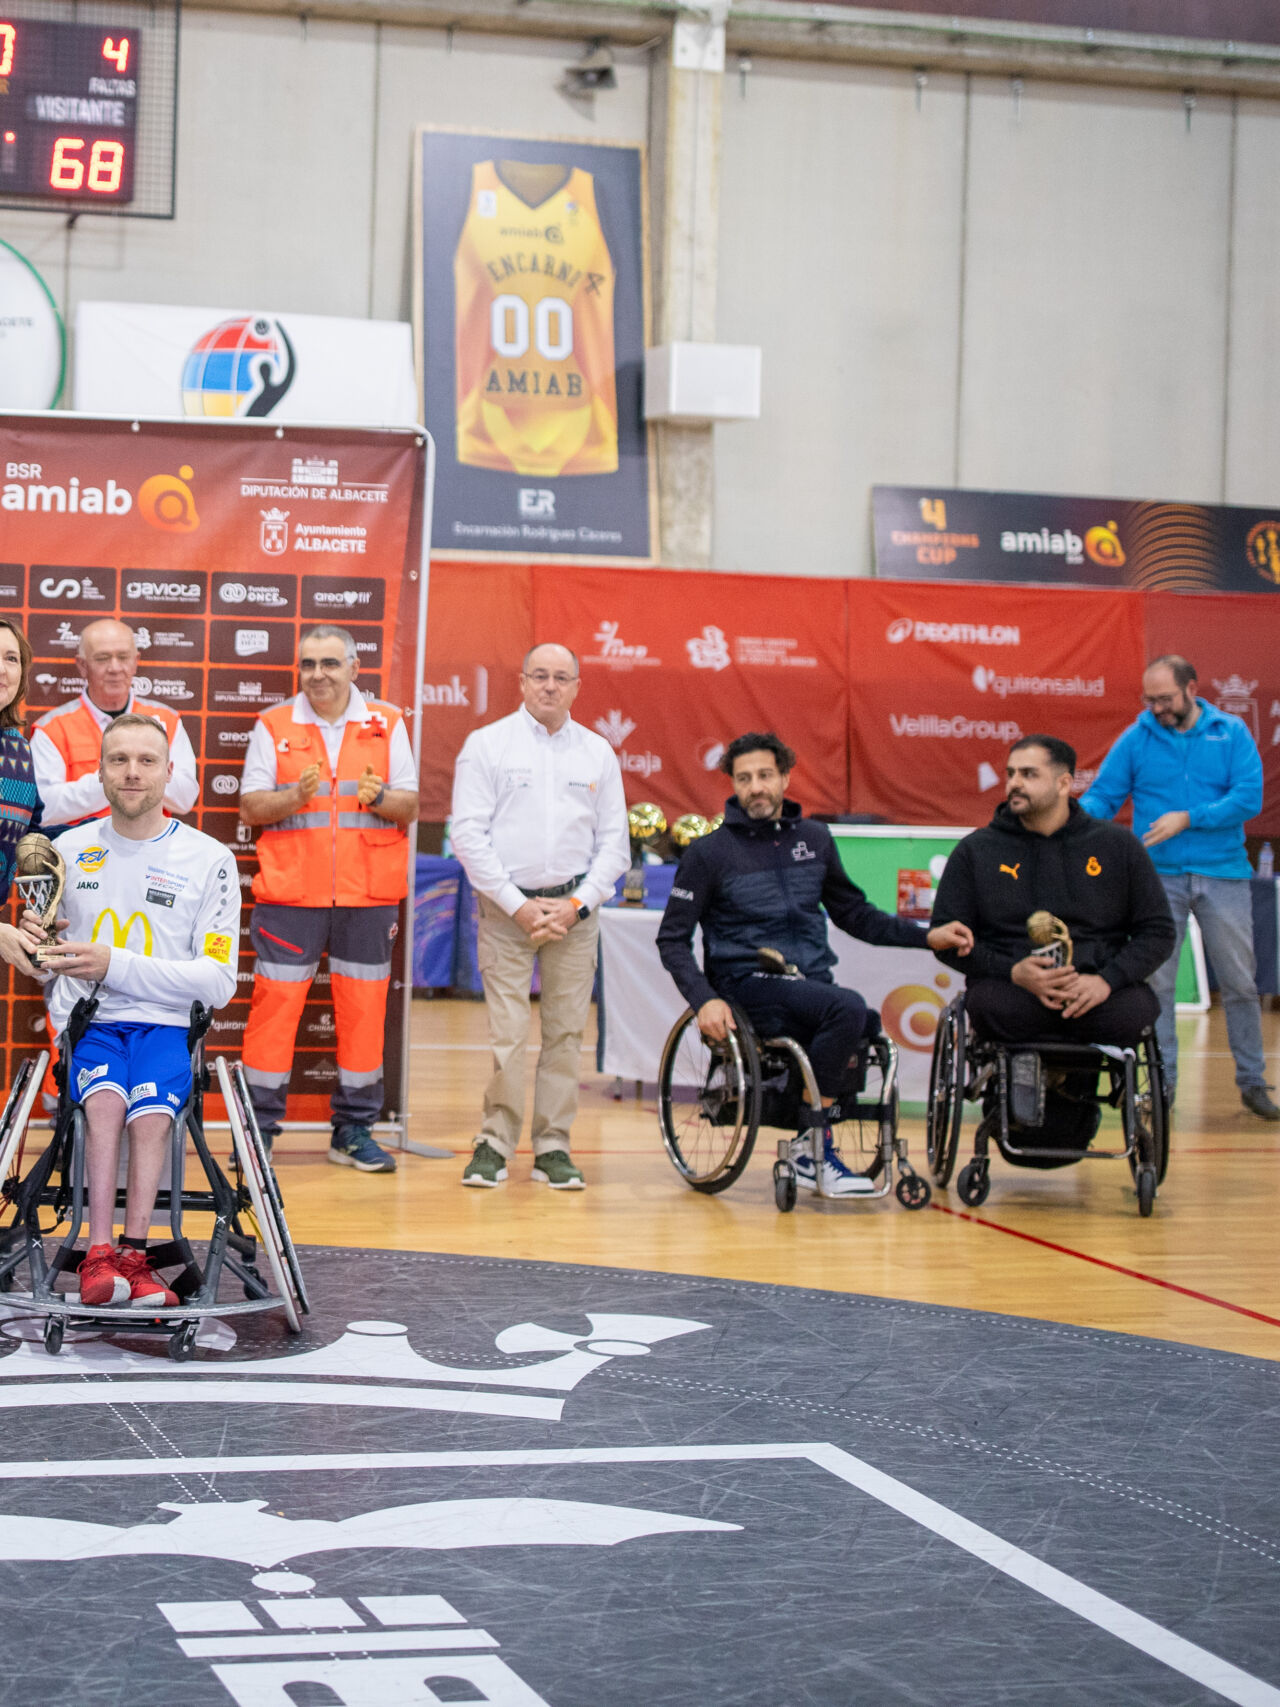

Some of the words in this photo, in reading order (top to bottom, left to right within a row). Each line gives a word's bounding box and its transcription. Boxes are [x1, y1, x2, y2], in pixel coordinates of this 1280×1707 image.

[101, 36, 131, 73] 4
[36, 96, 126, 126] VISITANTE
[50, 137, 125, 192] 68
[490, 293, 574, 361] 00
[486, 370, 583, 397] AMIAB
[5, 462, 42, 480] BSR
[0, 477, 133, 515] amiab
[240, 484, 309, 500] DIPUTACIÓN
[311, 487, 327, 500] DE
[329, 488, 389, 503] ALBACETE
[518, 488, 556, 511] ER
[295, 523, 367, 537] Ayuntamiento
[294, 537, 367, 553] ALBACETE
[1001, 527, 1083, 554] amiab
[916, 546, 957, 565] CUP
[126, 582, 201, 599] gaviota
[247, 592, 280, 601] ONCE
[914, 621, 1020, 646] DECATHLON
[154, 687, 185, 695] ONCE
[75, 849, 109, 864] RSV
[76, 881, 99, 890] JAKO
